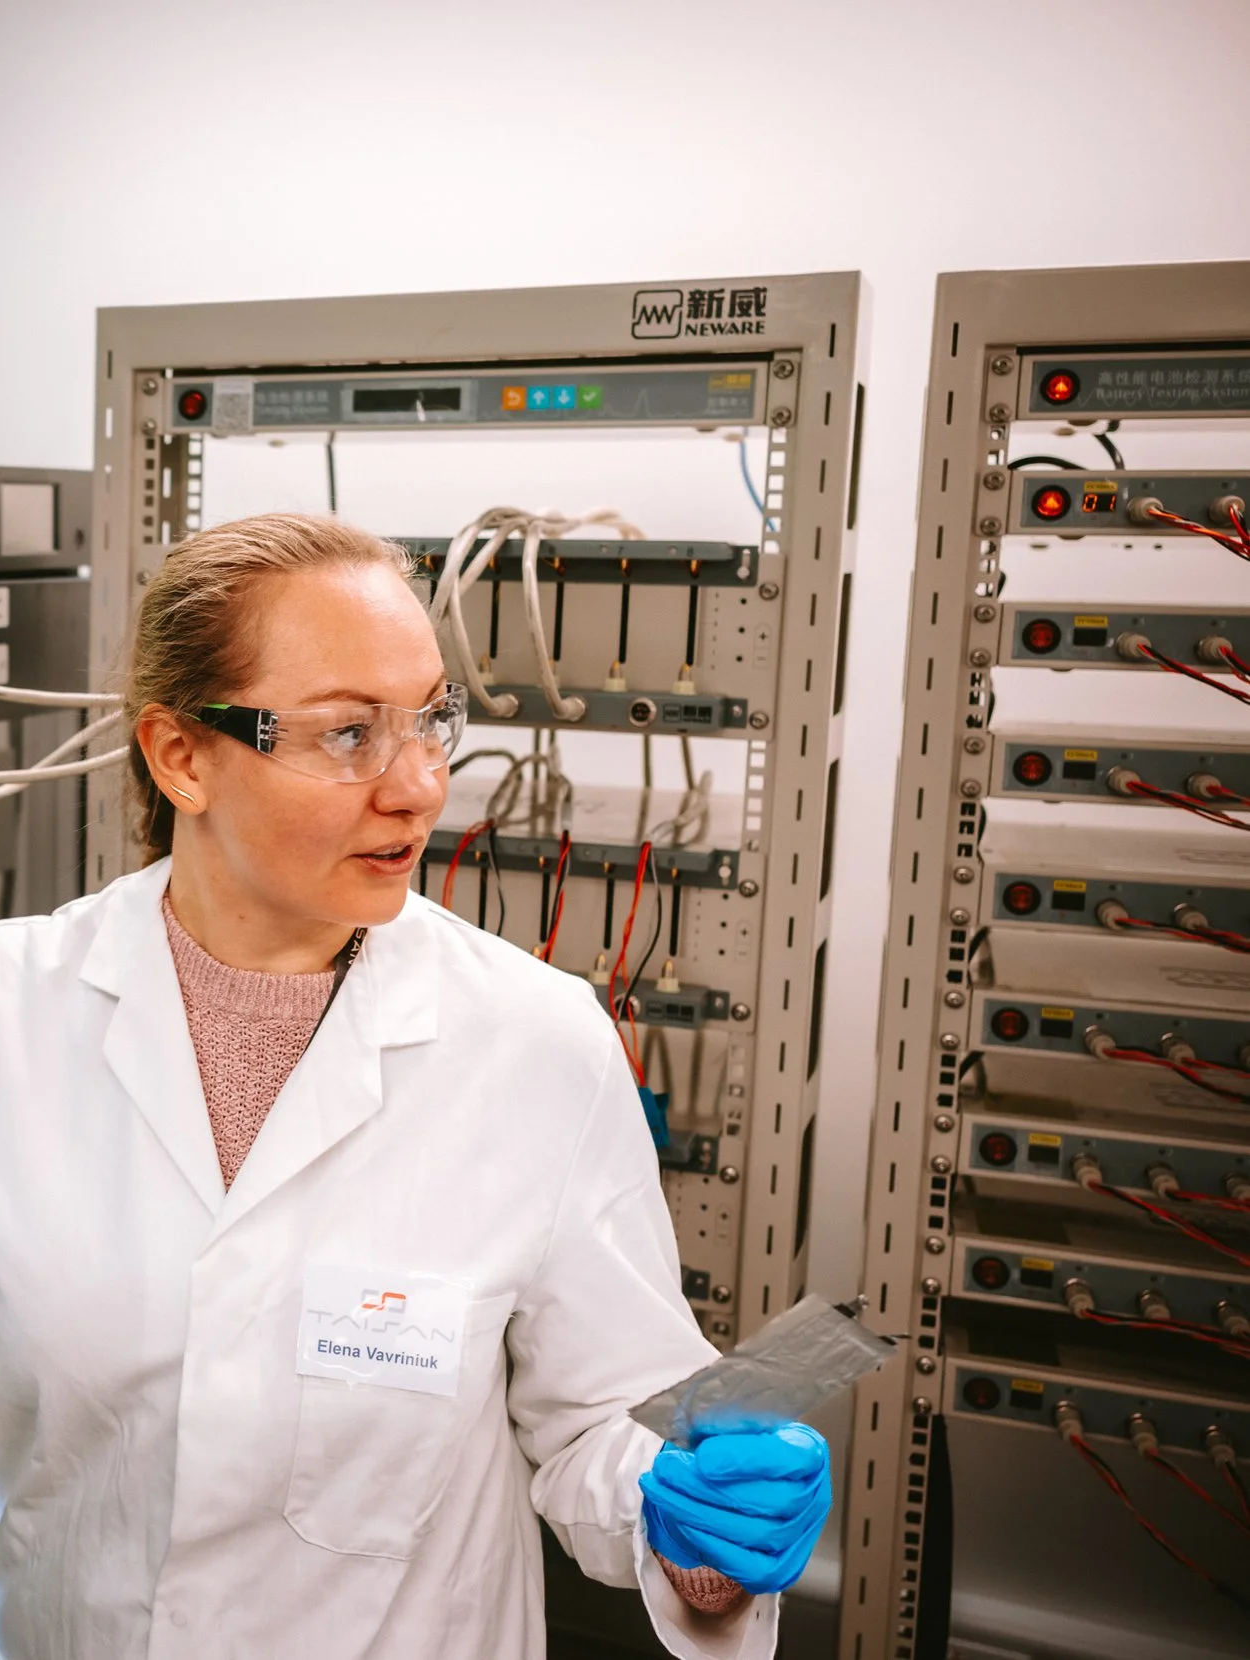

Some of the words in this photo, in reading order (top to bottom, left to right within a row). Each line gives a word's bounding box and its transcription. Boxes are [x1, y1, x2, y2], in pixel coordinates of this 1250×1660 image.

[686, 287, 767, 320] 新威
[685, 321, 766, 337] NEWARE
[1096, 387, 1142, 399] Battery
[307, 1308, 455, 1343] TAISAN
[317, 1339, 361, 1358] Elena
[366, 1347, 438, 1370] Vavriniuk
